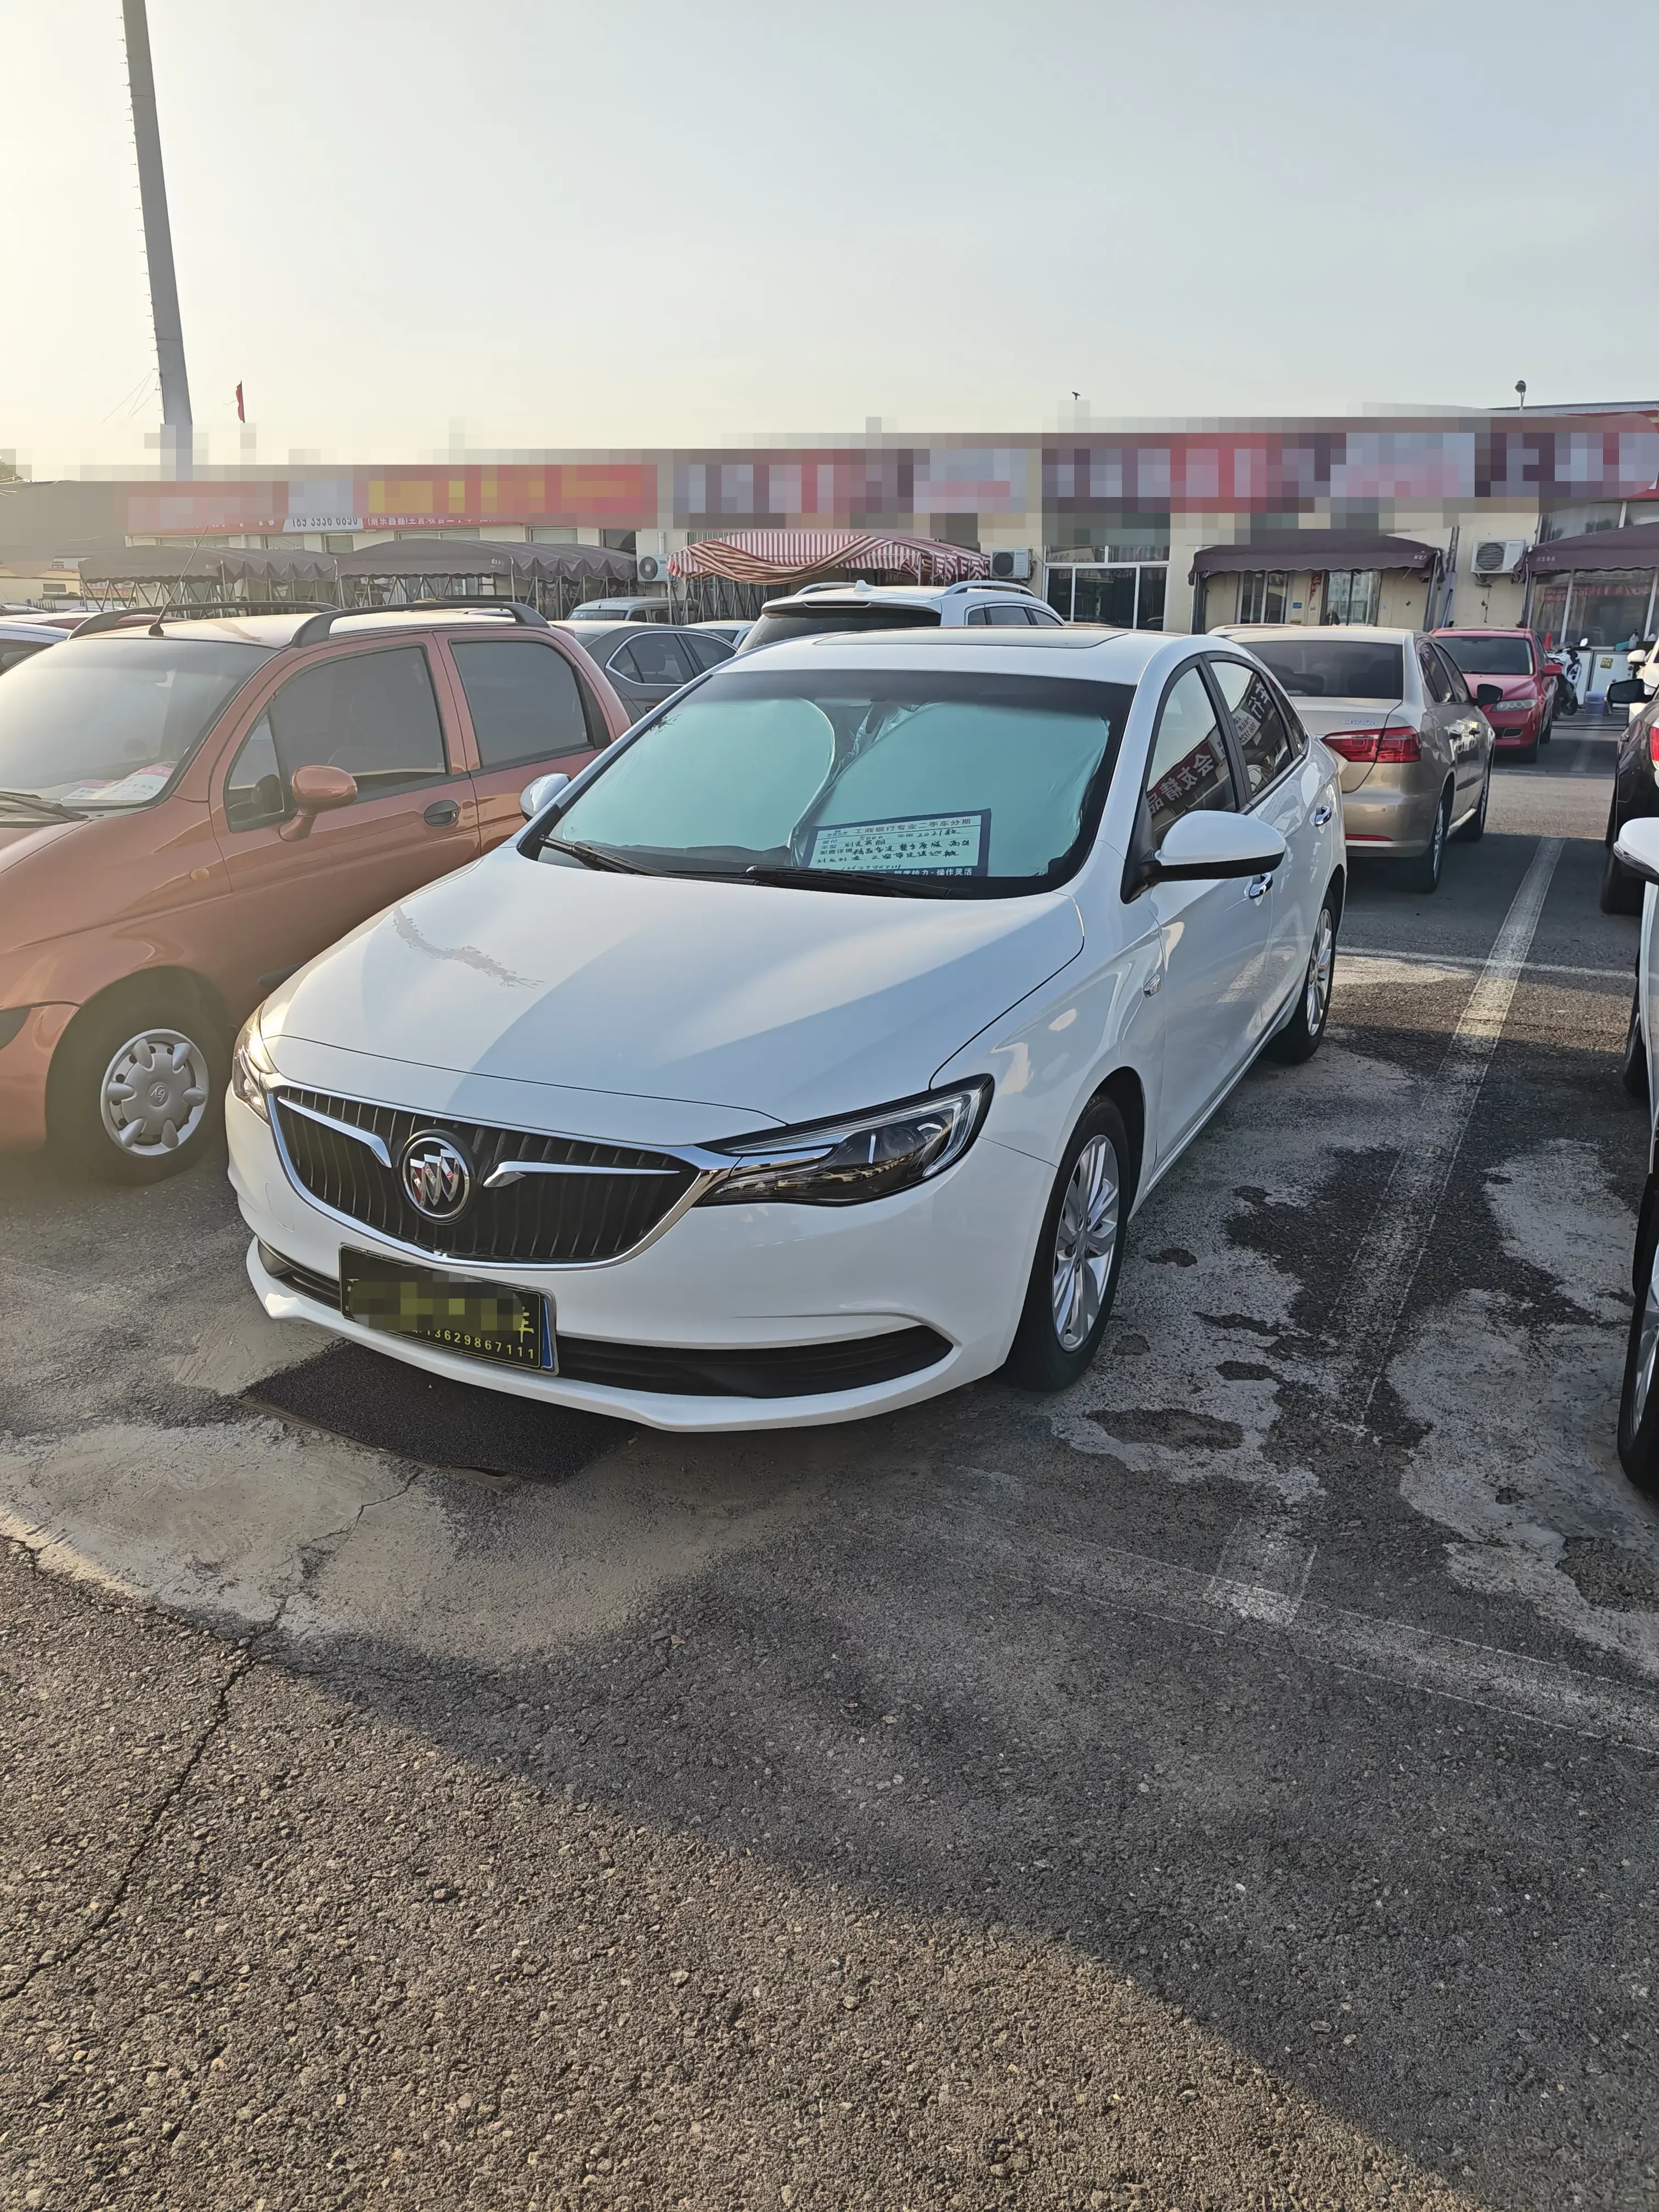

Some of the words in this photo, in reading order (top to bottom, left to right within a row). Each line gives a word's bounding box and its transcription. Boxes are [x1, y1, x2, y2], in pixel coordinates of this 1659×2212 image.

[854, 818, 972, 834] 工商银行专业二手车分期
